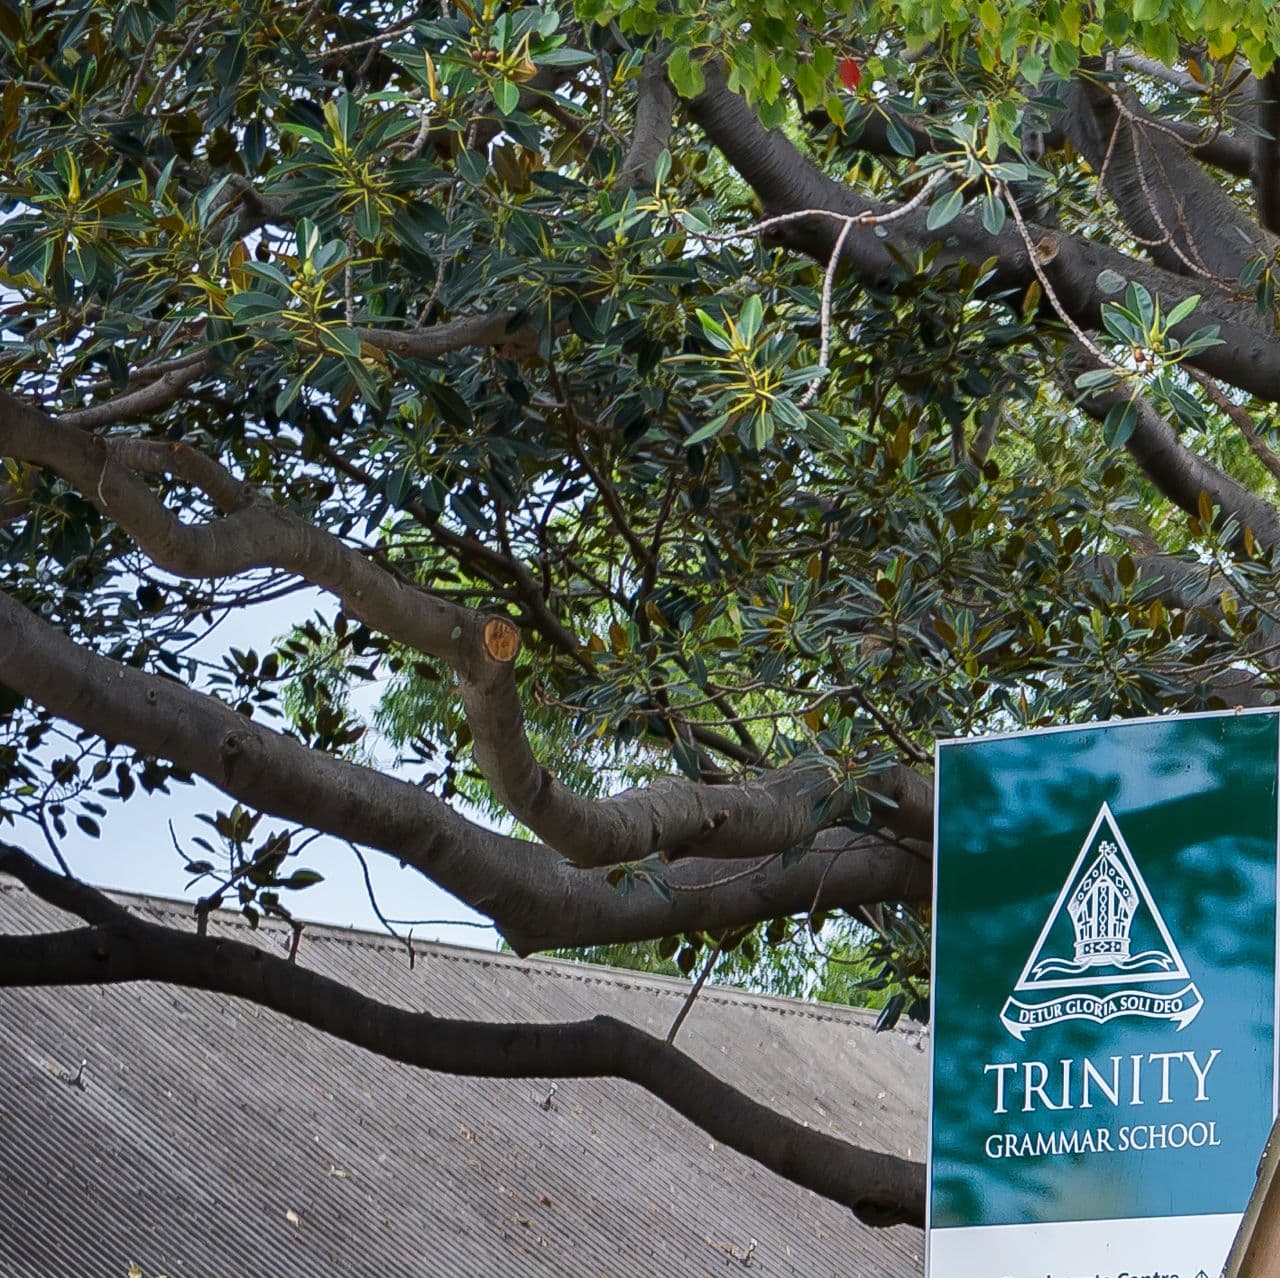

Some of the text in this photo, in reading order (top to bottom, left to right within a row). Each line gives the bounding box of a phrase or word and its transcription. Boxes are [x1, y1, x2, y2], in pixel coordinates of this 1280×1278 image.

[1018, 996, 1183, 1024] DETUR GLORIA SOLI DEO
[983, 1049, 1222, 1114] TRINITY
[985, 1121, 1222, 1159] GRAMMAR SCHOOL
